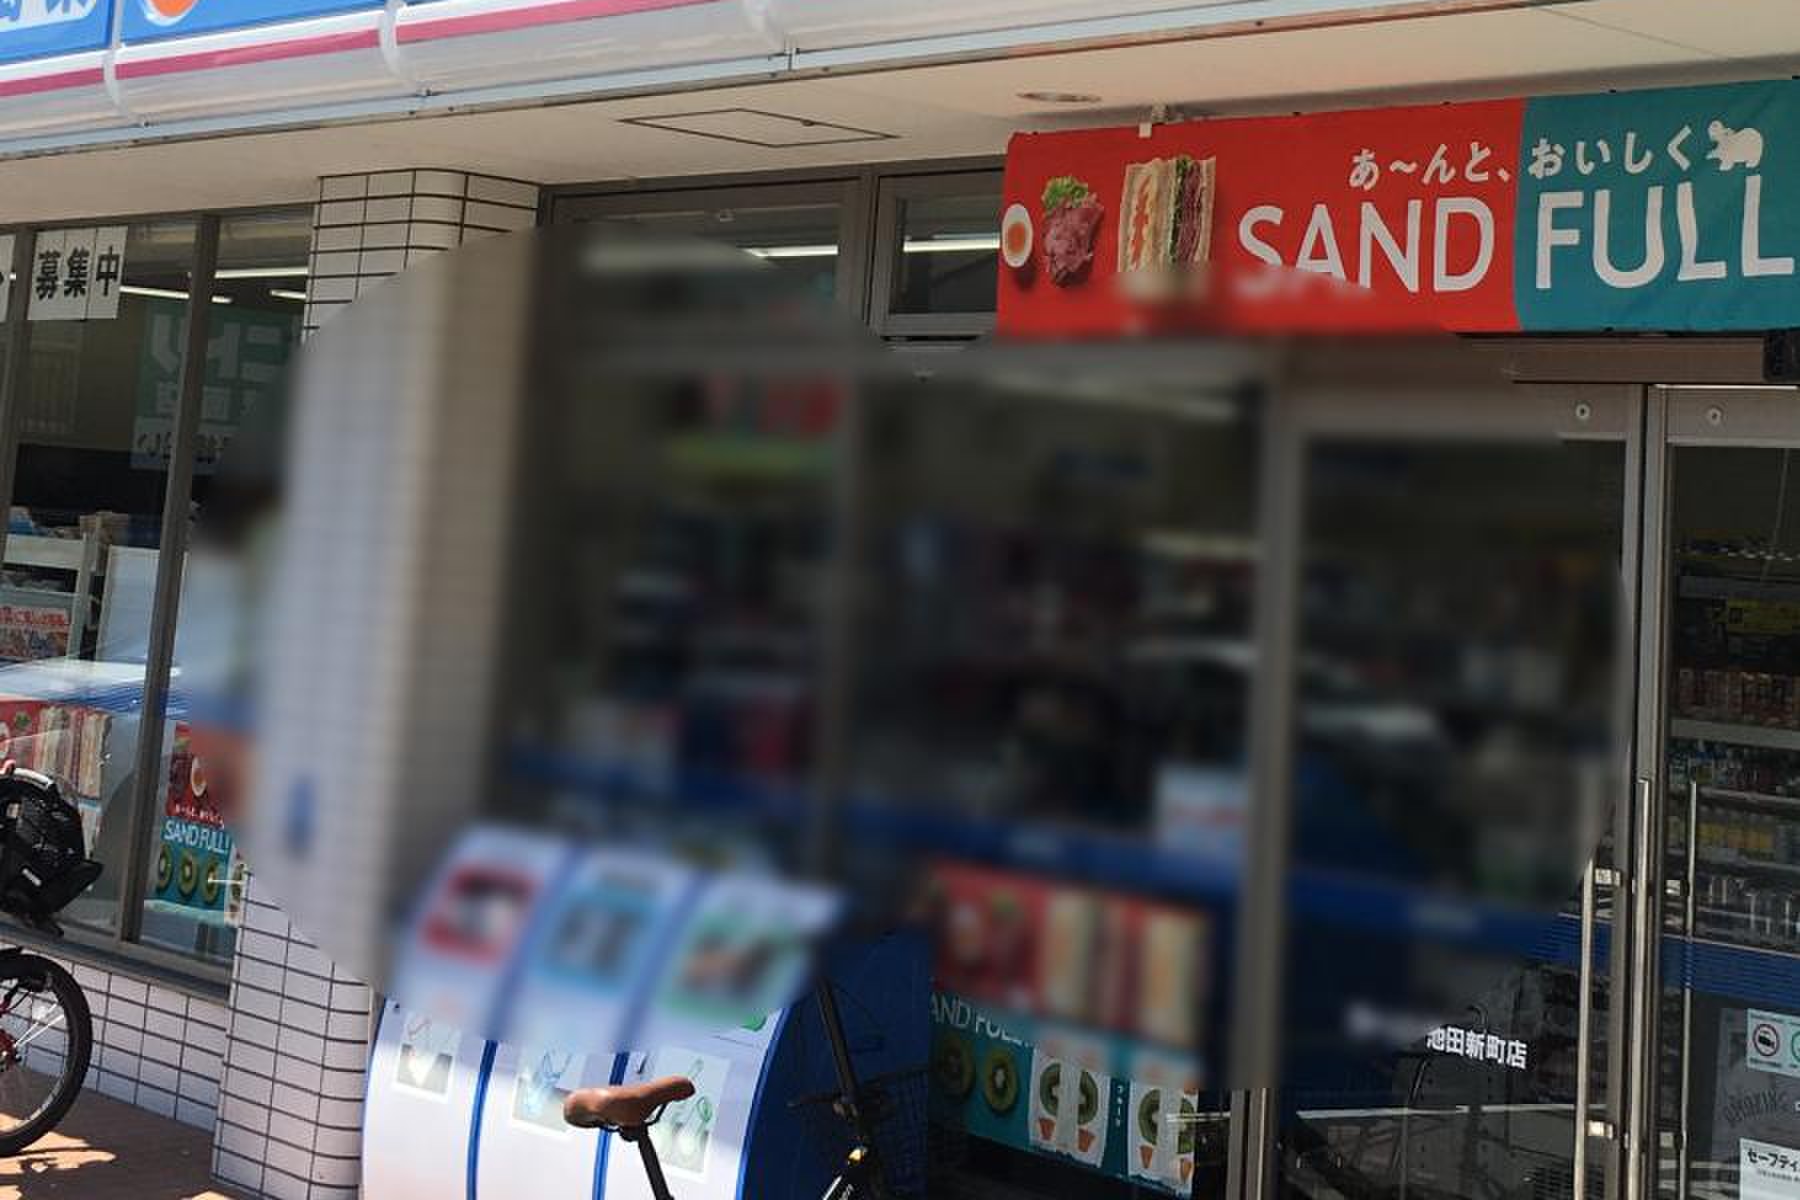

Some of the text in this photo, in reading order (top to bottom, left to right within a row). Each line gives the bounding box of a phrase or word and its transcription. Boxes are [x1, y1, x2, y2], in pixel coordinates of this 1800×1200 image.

[1238, 174, 1795, 294] SAND FULL
[36, 246, 120, 300] 募集中
[929, 993, 971, 1028] AND
[1426, 1026, 1527, 1070] 池田新町店
